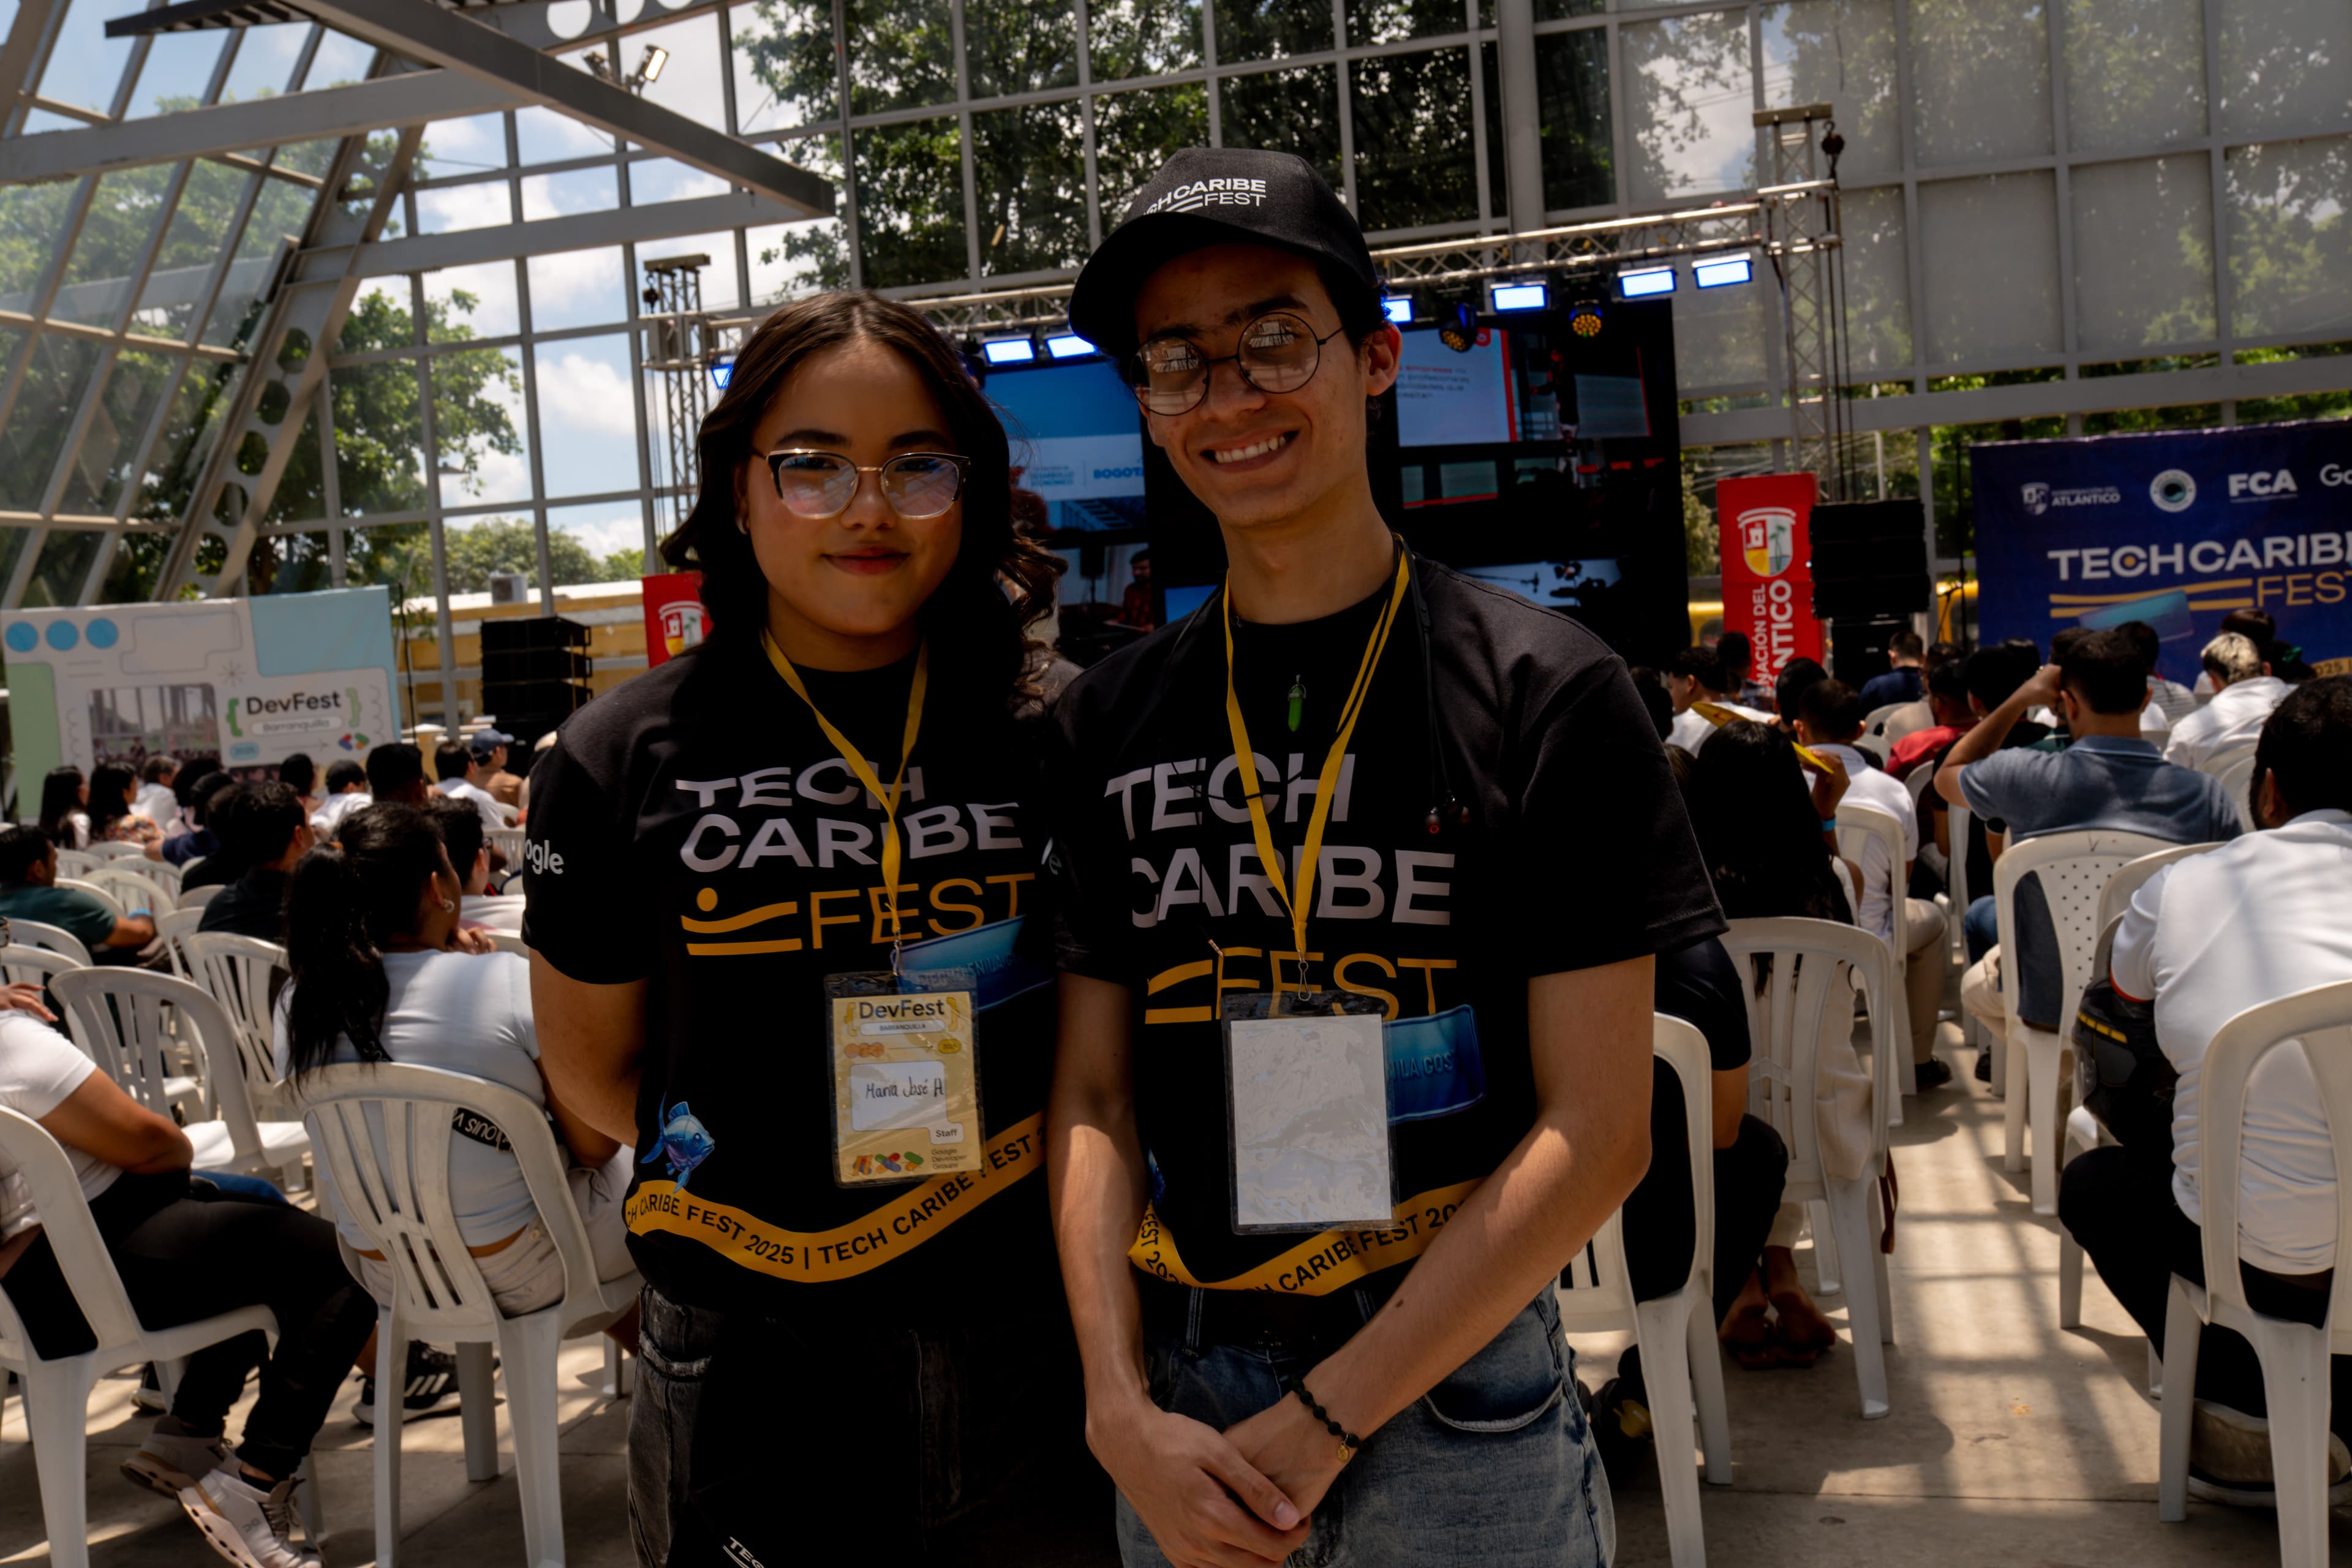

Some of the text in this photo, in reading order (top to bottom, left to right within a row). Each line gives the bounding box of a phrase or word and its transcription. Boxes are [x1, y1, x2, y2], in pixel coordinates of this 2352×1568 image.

[1143, 178, 1266, 214] CHCARIBE
[1205, 192, 1266, 207] FEST
[2227, 468, 2299, 497] FCA
[2047, 530, 2352, 581] TECHCARIB
[1752, 584, 1766, 616] DEL
[1768, 579, 1795, 685] NTICO
[246, 690, 341, 715] DevFest
[676, 758, 925, 810] TECH
[1104, 752, 1355, 840] TECH
[810, 872, 1035, 949] FEST
[859, 998, 945, 1020] DevFest
[1215, 946, 1457, 1021] FEST
[935, 1129, 957, 1137] Staff
[640, 1194, 680, 1216] CARIBE
[687, 1205, 745, 1240] FEST
[744, 1234, 794, 1265] 2025
[817, 1227, 889, 1264] TECH
[892, 1170, 974, 1235] CARIBE
[979, 1134, 1030, 1178] EST
[1278, 1200, 1464, 1291] CARIBE FEST 20
